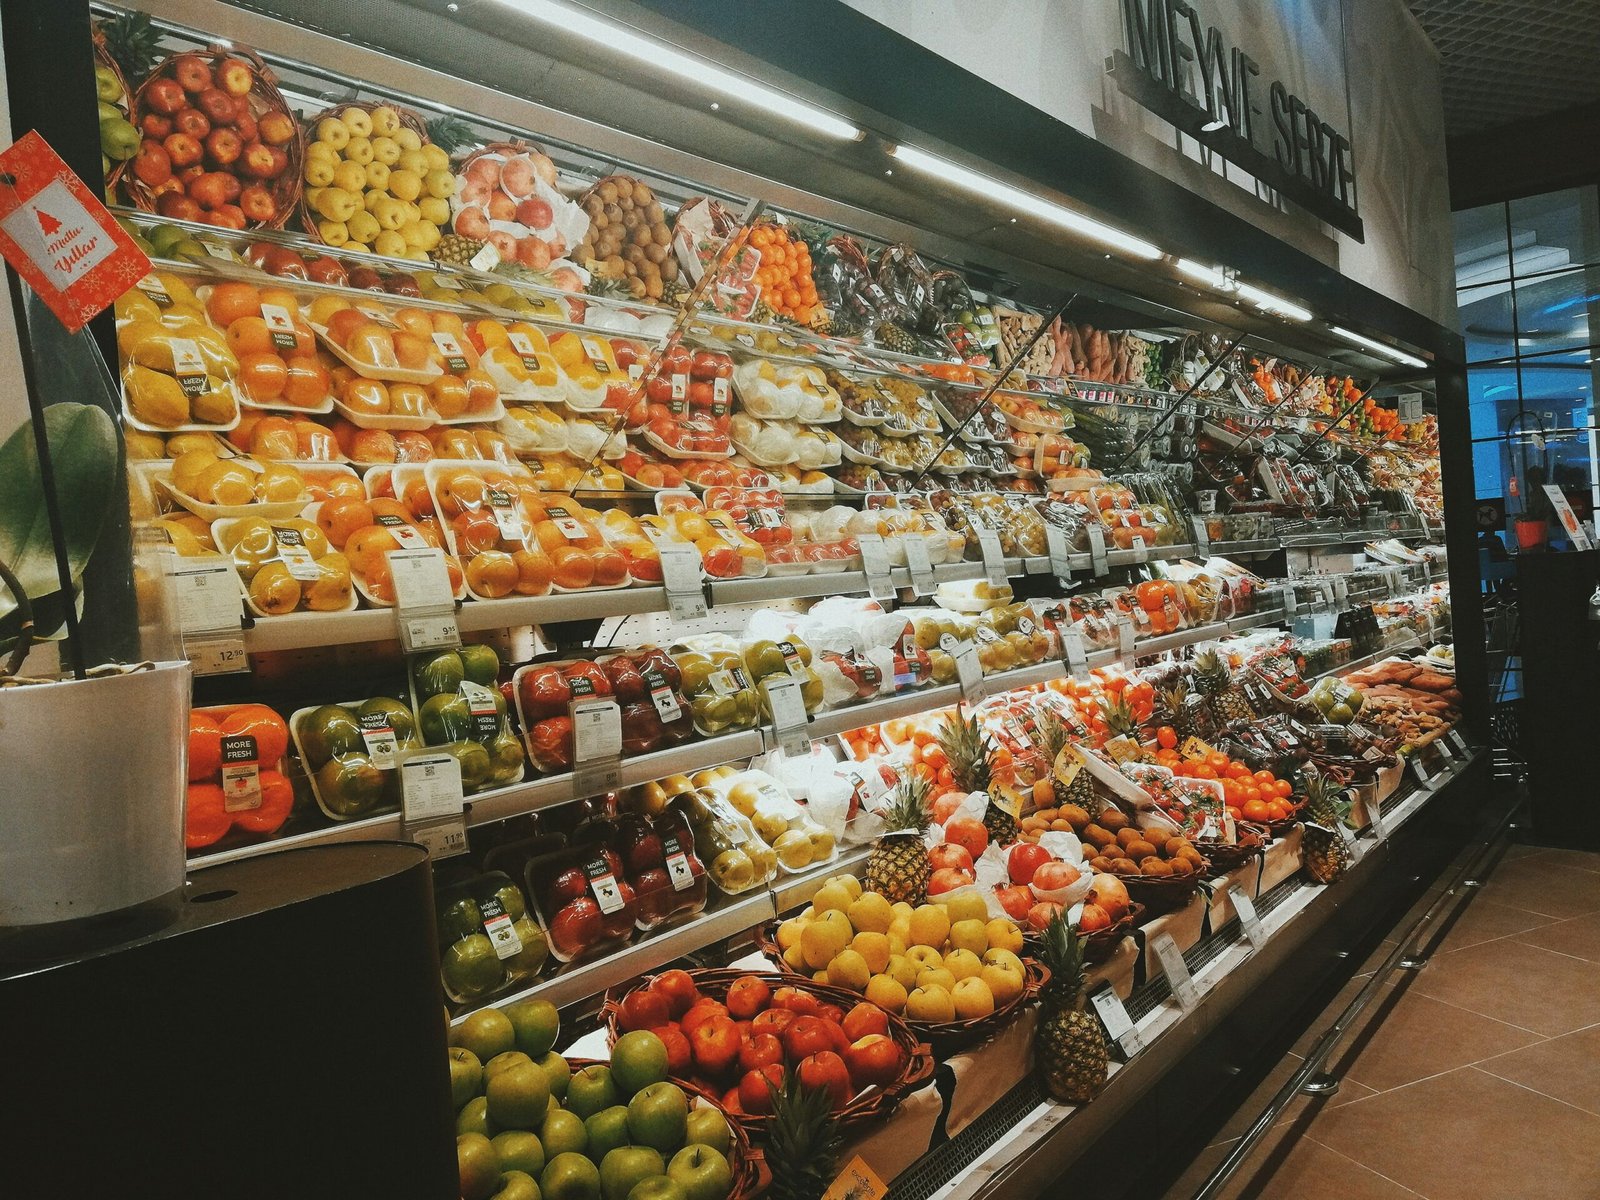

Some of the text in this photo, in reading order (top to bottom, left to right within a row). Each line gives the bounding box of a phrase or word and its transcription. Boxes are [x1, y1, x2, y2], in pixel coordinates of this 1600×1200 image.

[361, 713, 384, 721] MORE
[226, 740, 251, 749] MORE
[227, 750, 252, 759] FRESH
[587, 859, 605, 869] MORE
[590, 867, 607, 876] FRESH
[480, 900, 498, 910] MORE
[483, 907, 502, 917] FRESH
